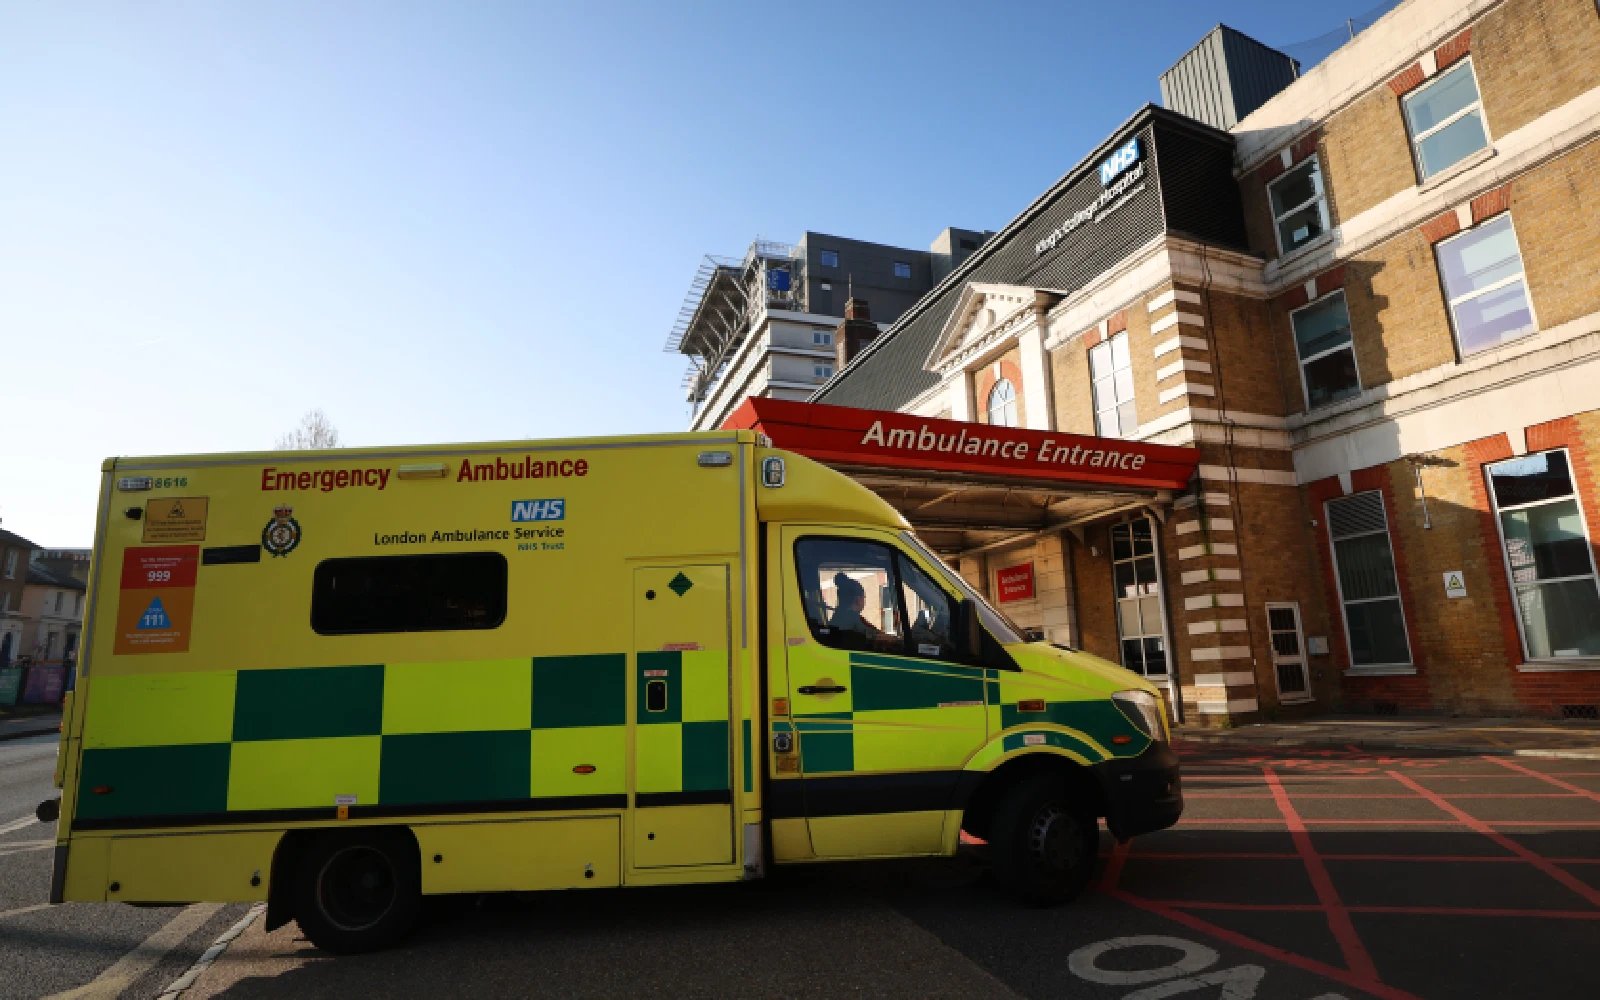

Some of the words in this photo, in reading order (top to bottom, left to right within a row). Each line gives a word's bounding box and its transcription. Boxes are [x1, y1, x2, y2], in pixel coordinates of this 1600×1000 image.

[1101, 137, 1138, 187] NHS
[861, 420, 1029, 460] Ambulance
[1036, 439, 1146, 471] Entrance
[155, 477, 188, 488] 8616
[261, 467, 392, 492] Emergency
[457, 455, 589, 482] Ambulance
[513, 500, 563, 521] NHS
[374, 531, 427, 545] London
[431, 529, 509, 543] Ambulance
[514, 527, 564, 539] Service
[517, 542, 538, 550] NHS
[541, 542, 565, 550] Trust
[147, 570, 171, 582] 999
[143, 614, 164, 626] 111
